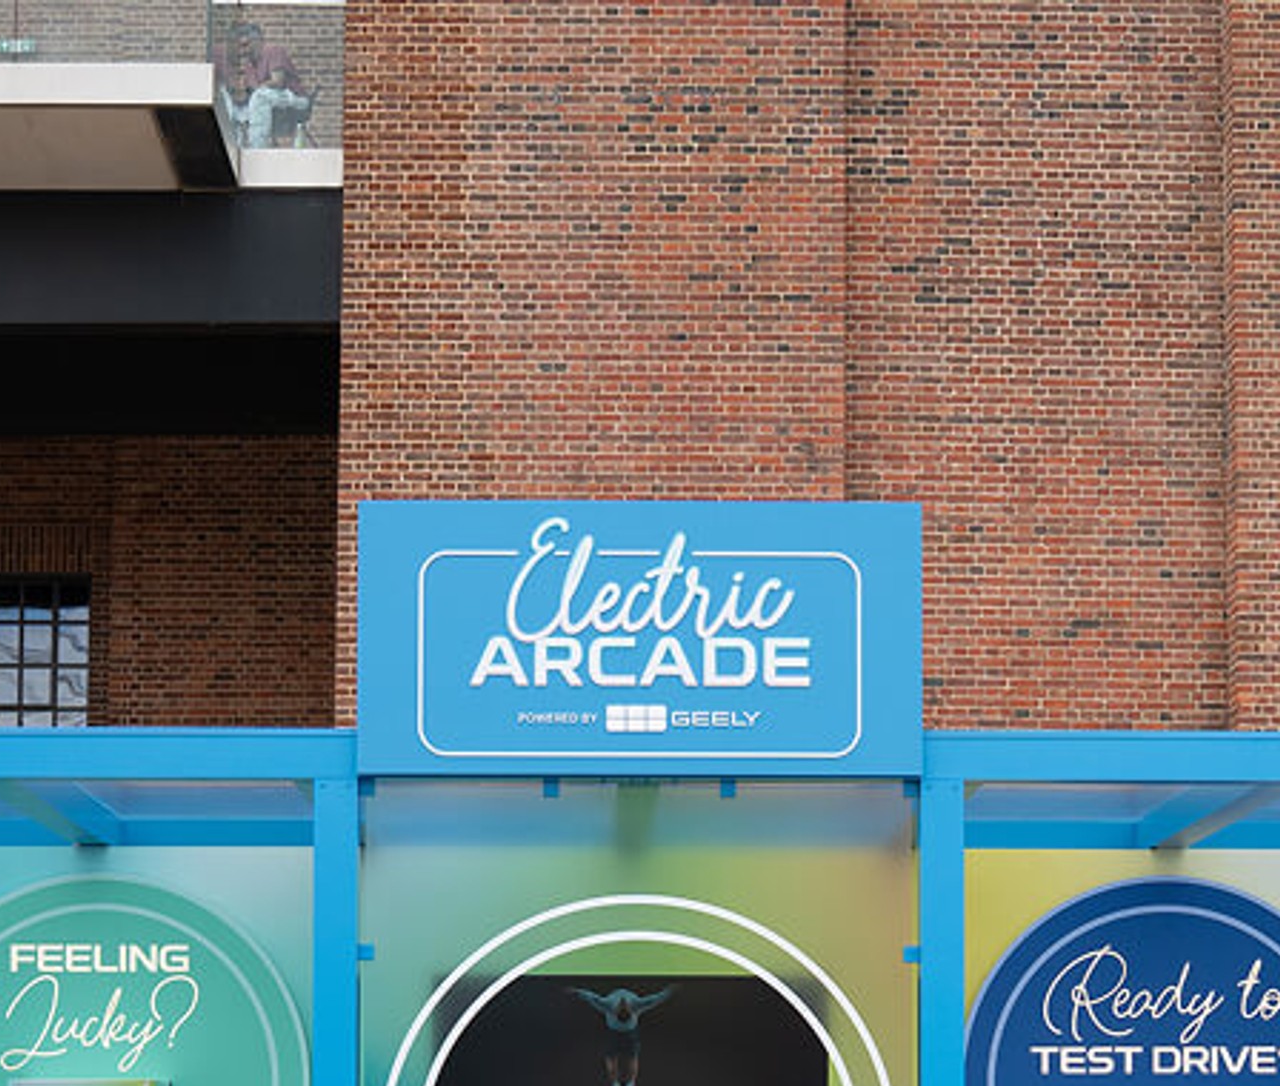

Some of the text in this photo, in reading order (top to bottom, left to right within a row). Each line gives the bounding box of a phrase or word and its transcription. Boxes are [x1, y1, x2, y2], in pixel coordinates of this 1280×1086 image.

[506, 517, 795, 643] Electric
[470, 636, 812, 687] ARCADE
[517, 710, 761, 727] POWERED BY GEELY
[9, 943, 190, 973] FEELING
[1042, 944, 1224, 1044] Ready
[0, 974, 199, 1072] Lucky?
[1029, 1045, 1144, 1075] TEST
